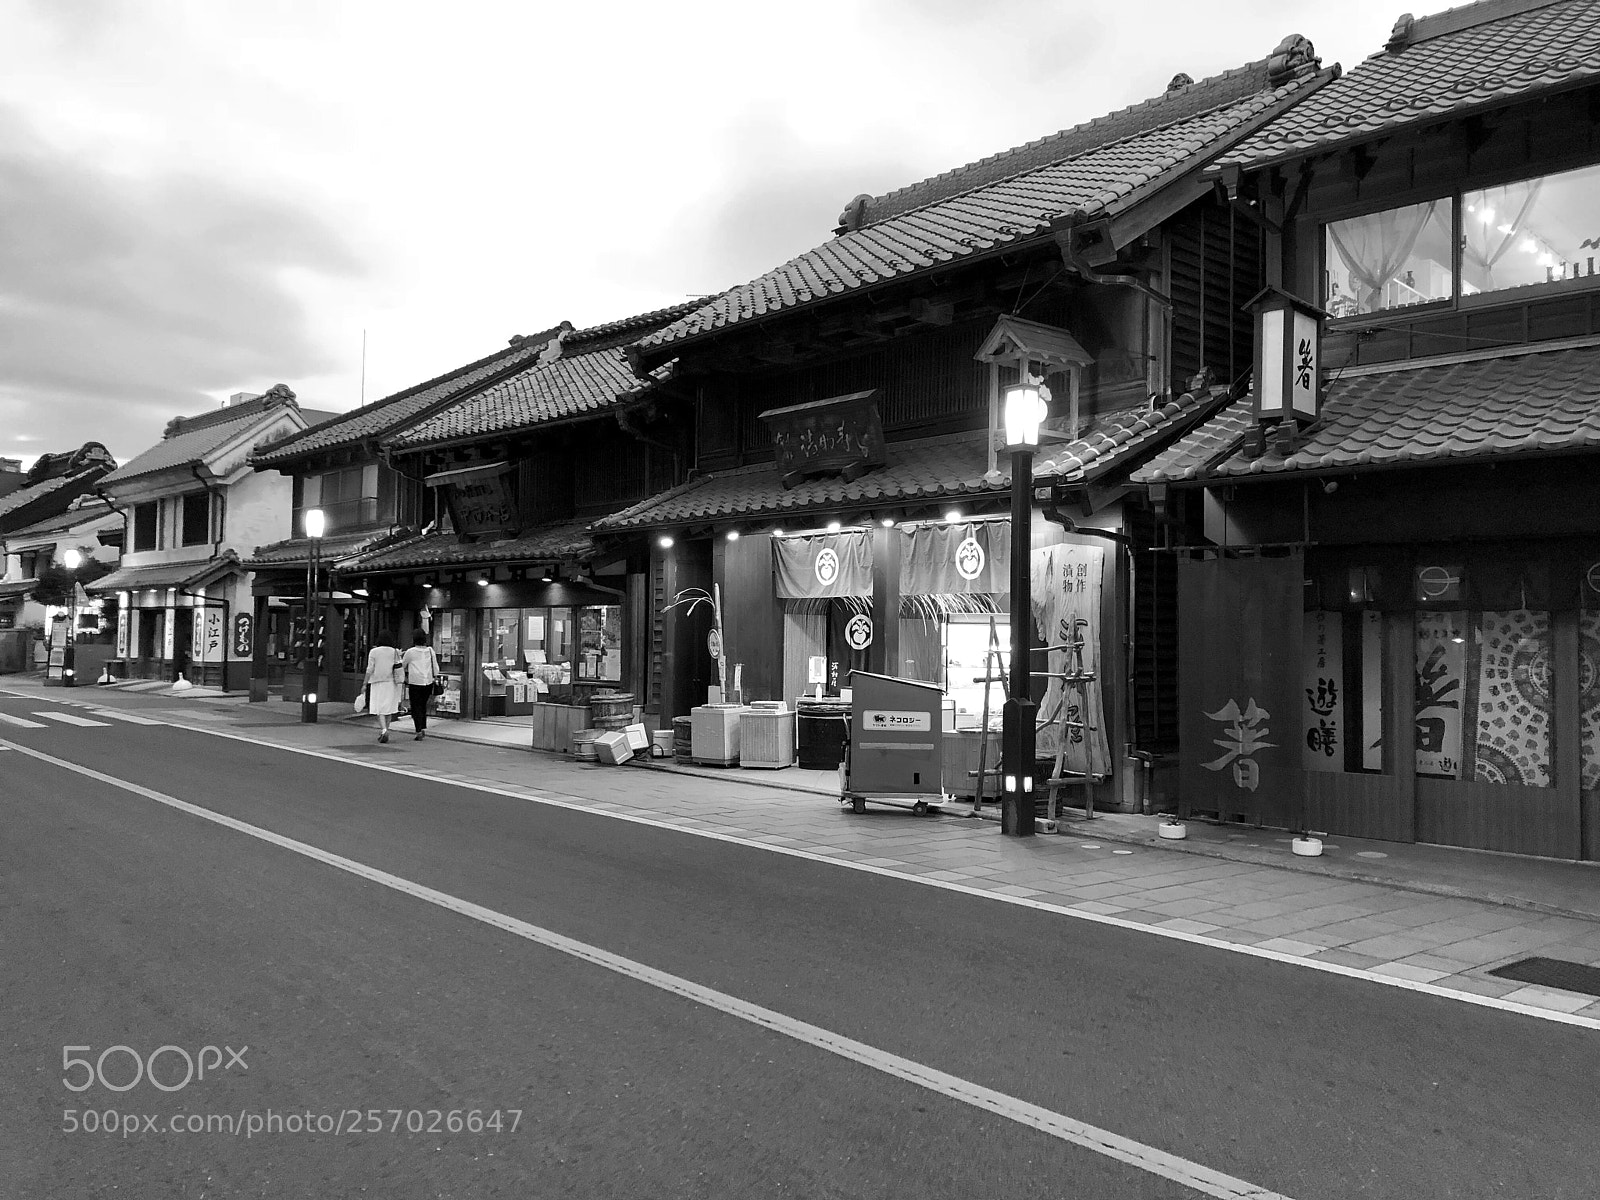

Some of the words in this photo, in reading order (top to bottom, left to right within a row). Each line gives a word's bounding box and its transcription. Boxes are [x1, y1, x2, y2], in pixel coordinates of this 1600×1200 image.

[1295, 338, 1314, 391] 箸
[207, 614, 220, 653] 小江戸
[236, 617, 250, 652] つけもの
[889, 715, 922, 724] ネコロジー
[1199, 696, 1281, 793] 箸
